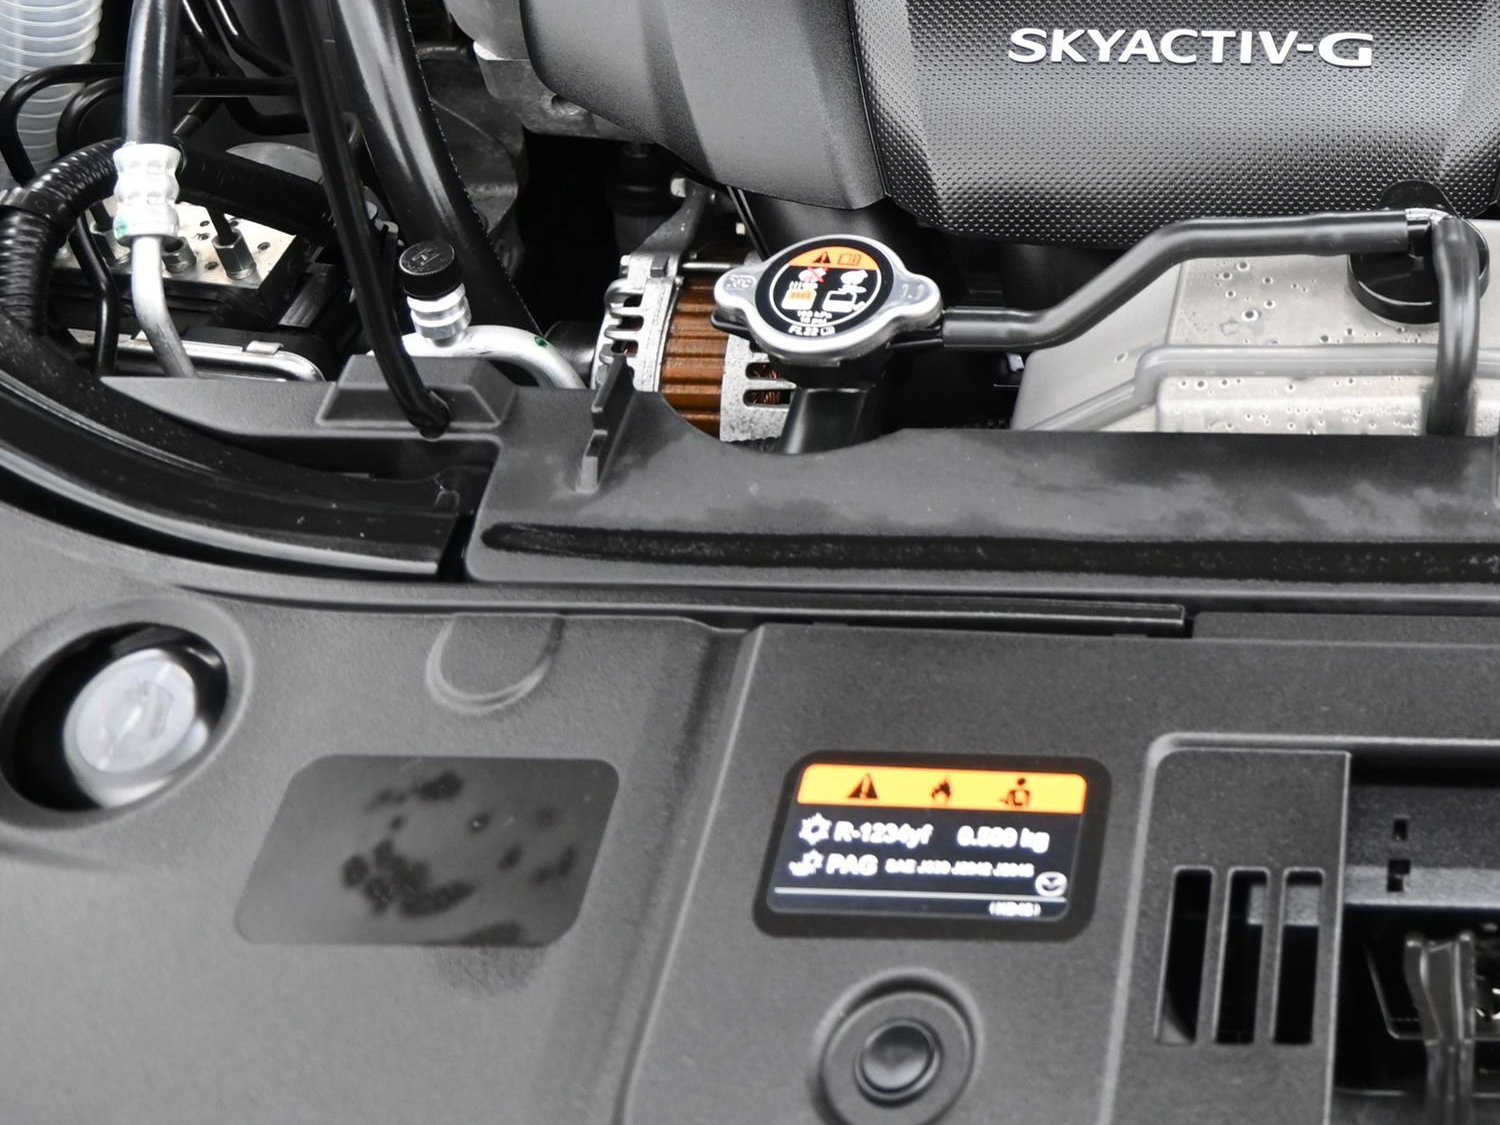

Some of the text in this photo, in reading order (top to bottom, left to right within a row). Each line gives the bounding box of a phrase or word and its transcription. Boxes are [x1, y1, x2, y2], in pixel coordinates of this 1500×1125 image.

[1007, 27, 1375, 69] SKYACTIV-G
[833, 821, 934, 848] R-1234yf
[1019, 828, 1050, 853] kg
[825, 853, 879, 876] PAG
